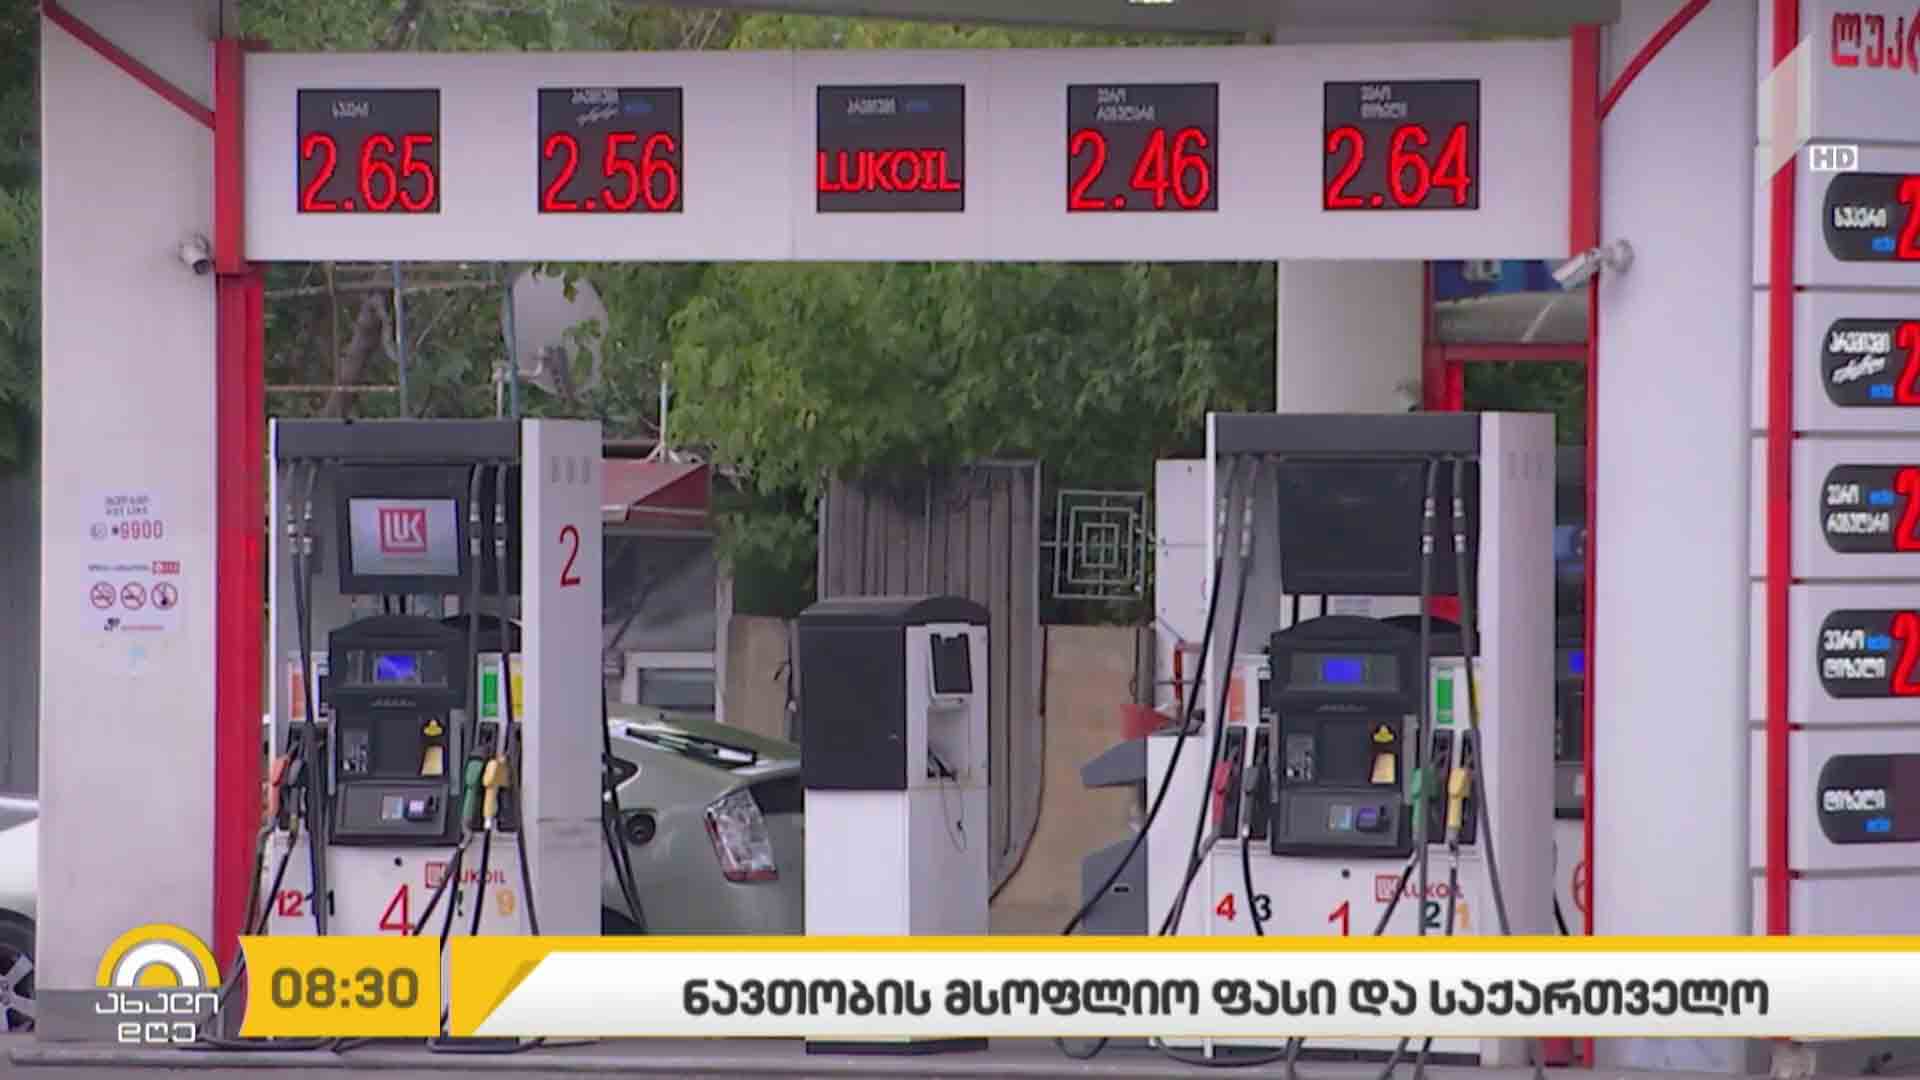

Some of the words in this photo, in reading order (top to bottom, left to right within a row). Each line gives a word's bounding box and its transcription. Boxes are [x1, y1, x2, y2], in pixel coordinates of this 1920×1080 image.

[302, 133, 435, 212] 2.65
[543, 132, 679, 212] 2.56
[816, 149, 961, 192] LUKOIL
[1070, 128, 1211, 210] 2.46
[1325, 124, 1472, 209] 2.64
[559, 525, 581, 587] 2
[1215, 892, 1236, 921] 4
[1254, 893, 1272, 921] 3
[1423, 901, 1441, 928] 2
